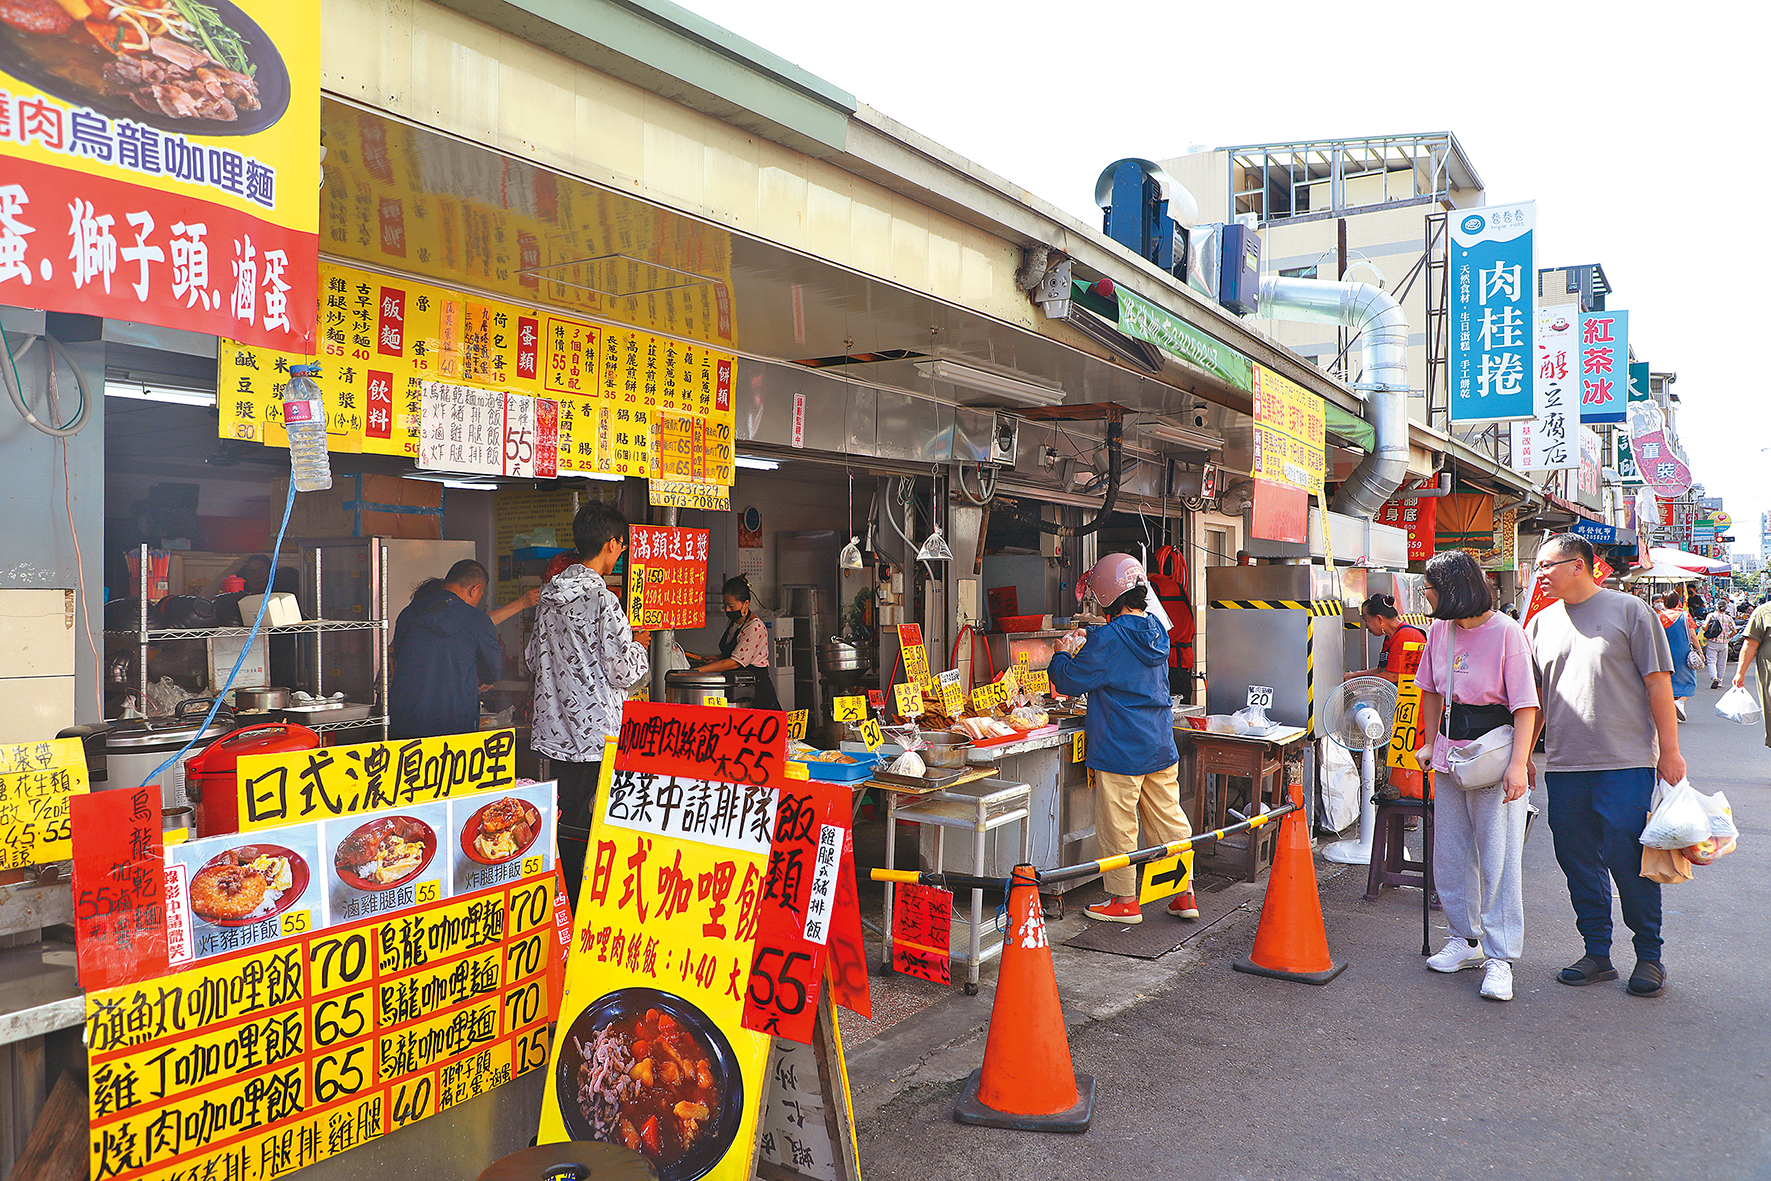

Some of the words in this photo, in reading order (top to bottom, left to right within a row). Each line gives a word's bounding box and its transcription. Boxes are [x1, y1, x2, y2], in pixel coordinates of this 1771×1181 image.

[326, 276, 348, 345] 雞腿炒麵
[352, 283, 373, 348] 古早味炒麵
[380, 295, 404, 351] 飯麵
[491, 311, 509, 371] 荷包蛋
[1477, 260, 1525, 398] 肉桂捲
[326, 344, 345, 357] 55
[352, 349, 370, 361] 40
[518, 325, 537, 374] 蛋類
[584, 348, 595, 375] 特價
[1582, 318, 1615, 405] 紅茶冰
[412, 358, 428, 371] 15
[491, 371, 507, 383] 15
[604, 390, 617, 400] 35
[624, 393, 637, 403] 20
[717, 366, 731, 407] 餅類
[368, 377, 392, 433] 飲料
[644, 396, 656, 406] 20
[663, 399, 675, 409] 20
[681, 402, 693, 412] 20
[698, 406, 710, 415] 20
[237, 424, 256, 439] 30
[578, 403, 593, 456] 香腸
[678, 417, 691, 433] 70
[716, 423, 730, 440] 70
[677, 438, 691, 454] 65
[716, 444, 730, 460] 70
[559, 458, 573, 468] 25
[578, 460, 592, 470] 25
[599, 458, 610, 470] 25
[616, 463, 628, 473] 30
[638, 465, 645, 475] 6
[675, 460, 690, 476] 65
[716, 465, 730, 480] 70
[1641, 441, 1678, 480] 童裝
[663, 493, 730, 511] 0913-708768
[632, 529, 708, 562] 滿額送豆漿
[901, 695, 919, 714] 35
[993, 682, 1008, 703] 55
[1250, 693, 1269, 706] 20
[842, 707, 859, 720] 25
[617, 715, 721, 764] 咖哩肉絲飯
[863, 720, 880, 747] 30
[245, 731, 515, 823] 日式濃厚咖哩
[608, 769, 773, 844] 營業中請排隊
[129, 789, 162, 935] 烏龍乾麵
[764, 794, 816, 914] 飯類
[464, 861, 522, 890] 炸腿排飯
[523, 858, 541, 875] 55
[78, 886, 114, 920] 55
[342, 884, 413, 921] 滷雞腿飯
[417, 883, 437, 903] 55
[198, 918, 278, 954] 炸豬排飯
[283, 912, 306, 933] 55
[87, 946, 303, 1052] 旗魚丸咖哩飯
[309, 934, 367, 990] 70
[379, 897, 506, 973] 烏龍咖哩麵
[509, 884, 547, 935] 70
[749, 947, 812, 1014] 55
[93, 1010, 303, 1120] 雞丁咖哩飯
[314, 997, 366, 1047] 65
[377, 954, 499, 1028] 烏龍咖哩麵
[508, 934, 543, 975] 70
[94, 1072, 303, 1180] 燒肉咖哩飯
[314, 1047, 365, 1095] 65
[378, 1001, 496, 1080] 烏龍咖哩麵
[506, 982, 542, 1027] 70
[392, 1079, 431, 1126] 40
[516, 1026, 547, 1070] 15
